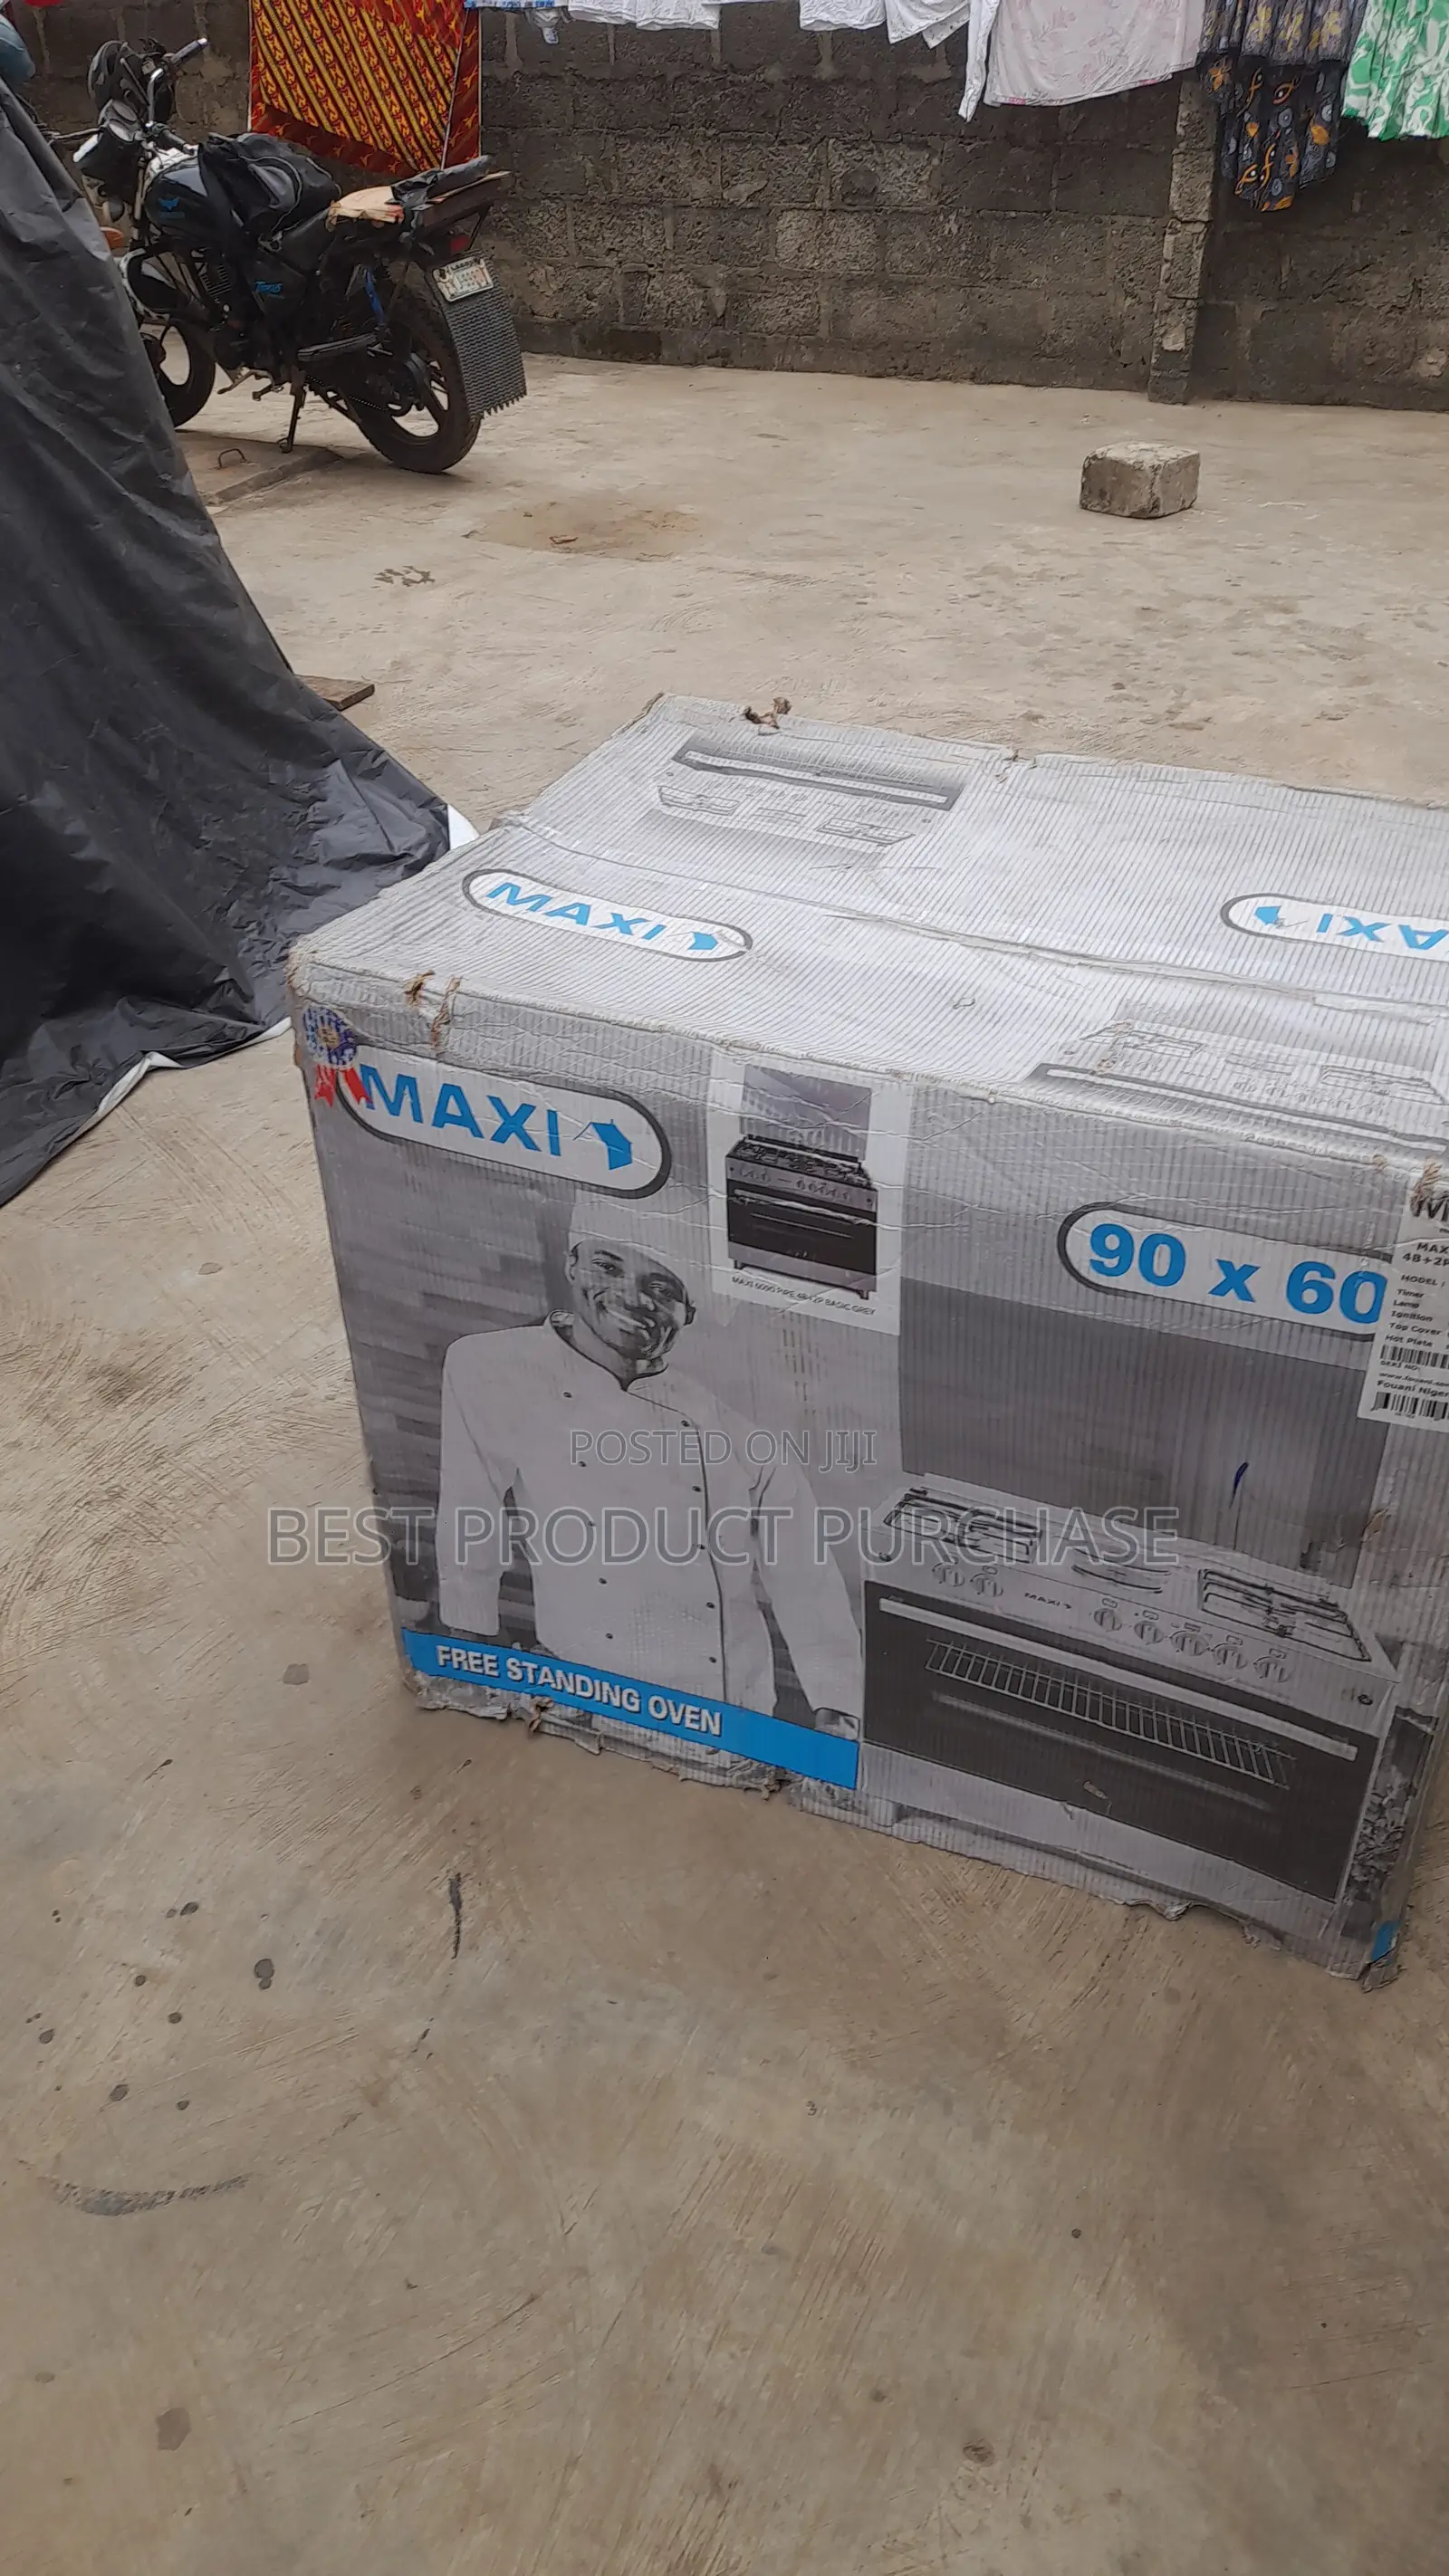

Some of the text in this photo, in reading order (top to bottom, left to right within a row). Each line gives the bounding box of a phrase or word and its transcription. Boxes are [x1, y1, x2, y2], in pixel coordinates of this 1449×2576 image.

[485, 882, 667, 941] MAXI
[1316, 913, 1449, 962] AXI
[360, 1063, 561, 1157] MAXI
[1089, 1223, 1186, 1287] 90
[1286, 1261, 1387, 1325] 60
[1397, 1288, 1425, 1298] Timer
[1394, 1299, 1420, 1309] Lamp
[1391, 1310, 1433, 1322] Ignition
[1388, 1322, 1443, 1336] Top Cover
[1385, 1334, 1433, 1347] Hot Plate
[1377, 1379, 1416, 1392] Fouani
[436, 1644, 724, 1738] FREE STANDING OVEN
